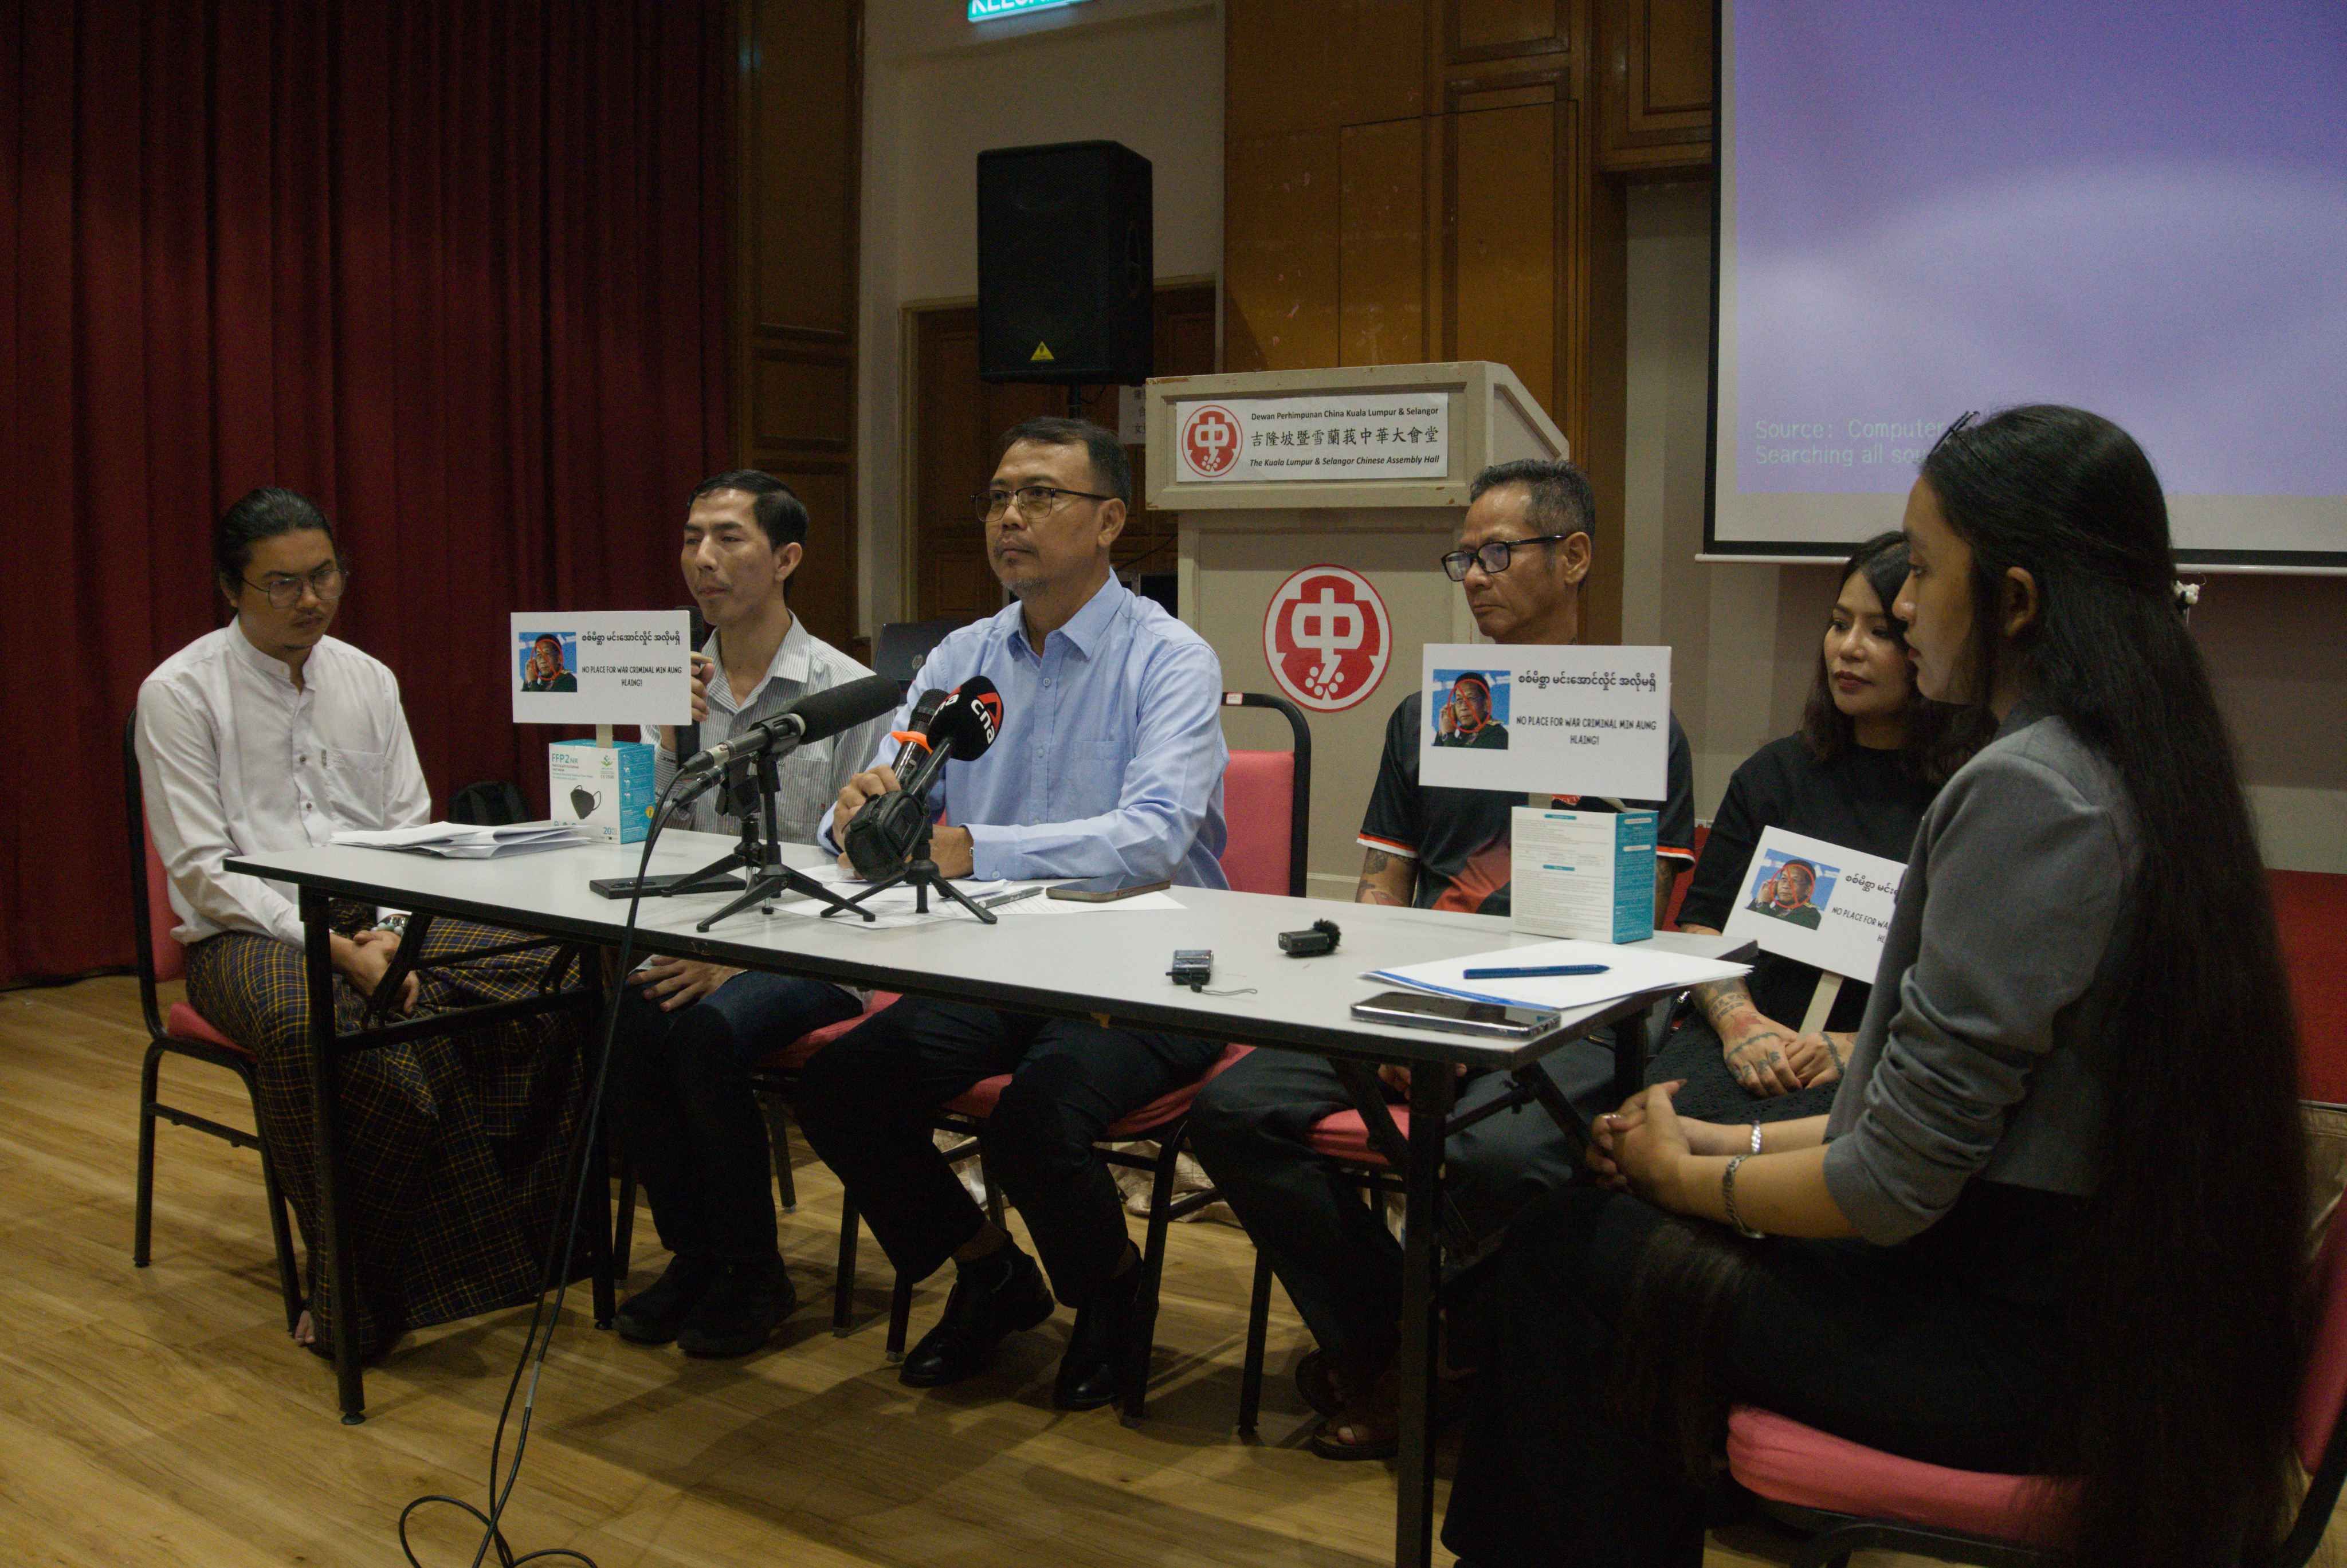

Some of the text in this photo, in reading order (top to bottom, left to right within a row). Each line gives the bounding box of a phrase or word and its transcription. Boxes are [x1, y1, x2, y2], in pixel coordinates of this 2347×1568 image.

[1251, 412, 1275, 421] Dewan
[1277, 411, 1322, 422] Perhimpunan
[1324, 410, 1344, 418] China
[1346, 409, 1367, 417] Kuala
[1368, 408, 1396, 418] Lumpur
[1406, 407, 1439, 417] Selangor
[1251, 426, 1440, 447] 吉隆坡暨雪蘭莪中華大會堂
[1755, 420, 1833, 439] Source:
[1250, 459, 1262, 467] The
[1264, 458, 1284, 466] Kuala
[1286, 458, 1313, 467] Lumpur
[1322, 457, 1355, 467] Selangor
[1356, 457, 1384, 465] Chinese
[1386, 455, 1422, 466] Assembly
[1423, 455, 1439, 463] Hall
[1755, 445, 1927, 466] Searching all sou
[617, 666, 629, 674] WAR
[630, 666, 654, 674] CRIMINAL
[621, 678, 642, 686] HLAING!
[970, 699, 996, 745] cna
[1516, 716, 1657, 730] NO PLACE FOR WAR CRIMINAL MIN AUNG
[1570, 734, 1600, 745] HLAING!
[551, 753, 570, 763] FFP2
[1831, 907, 1889, 929] NO PLACE FOR WA
